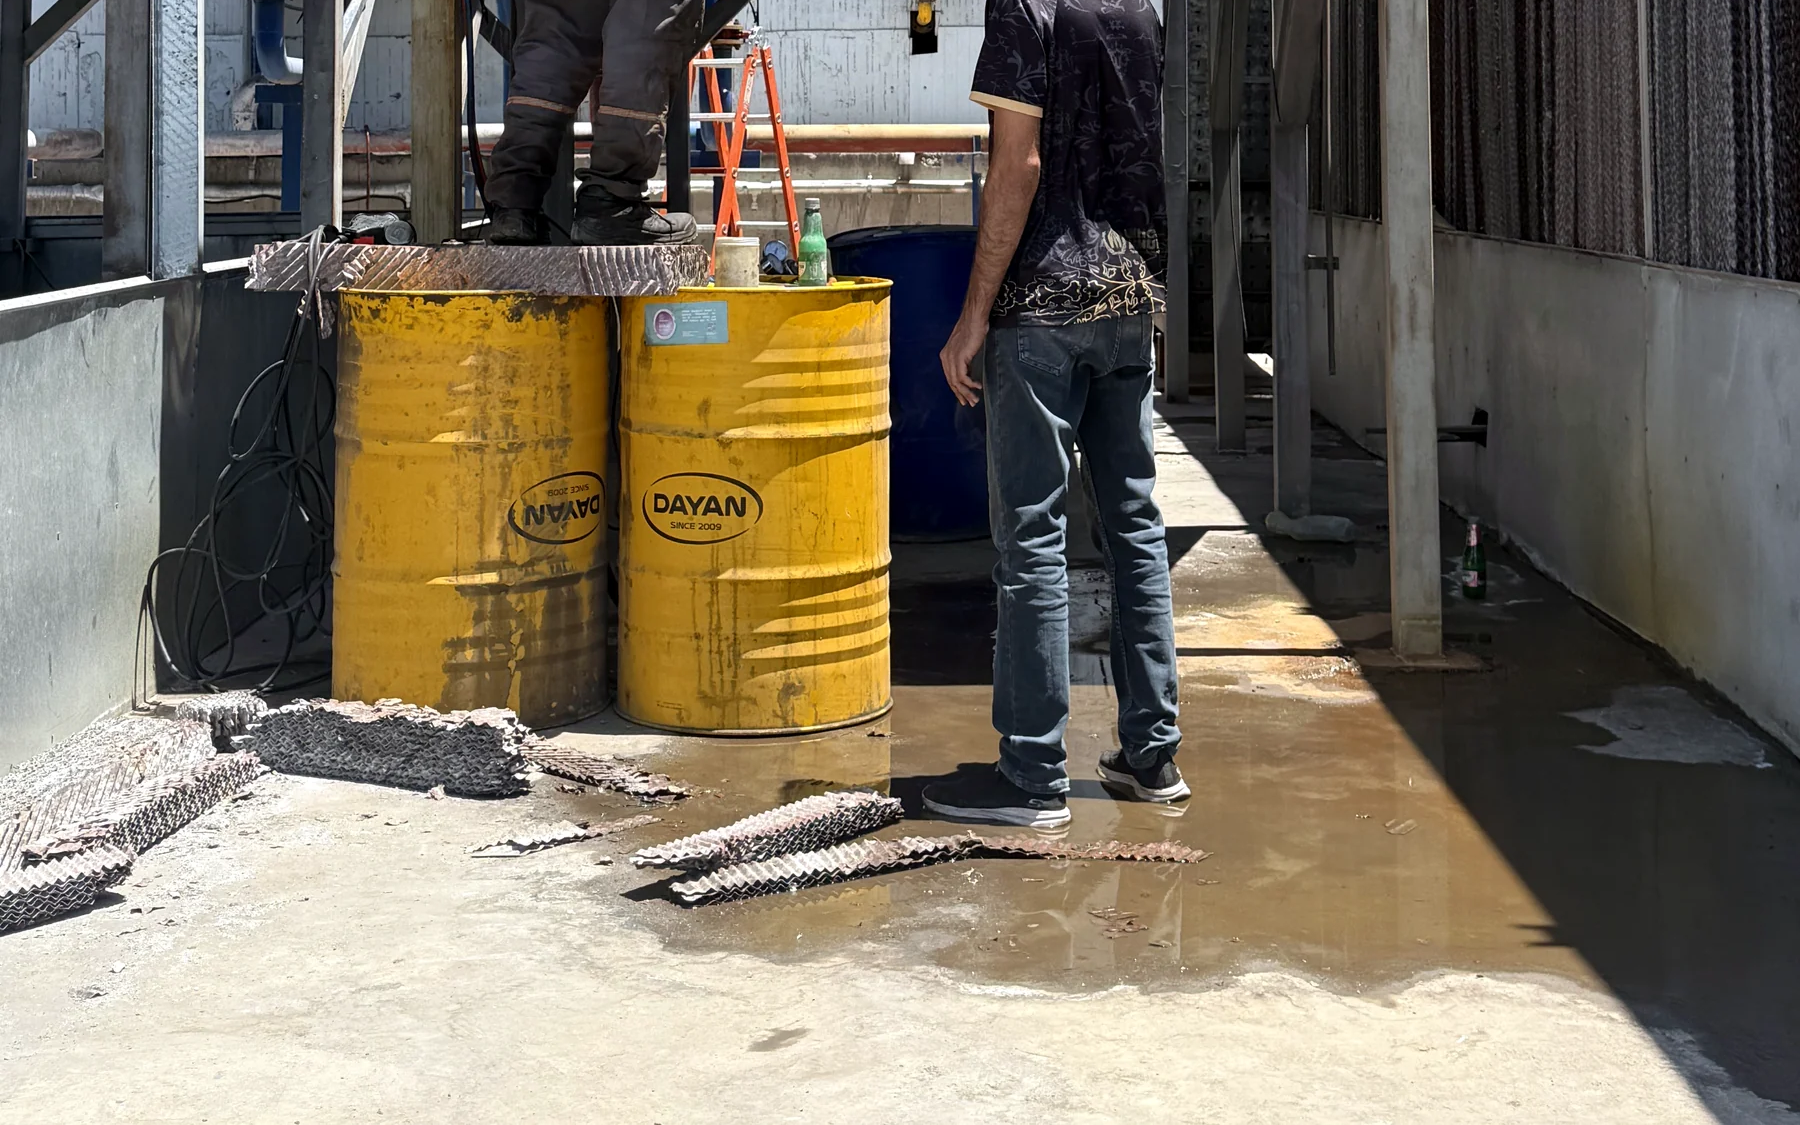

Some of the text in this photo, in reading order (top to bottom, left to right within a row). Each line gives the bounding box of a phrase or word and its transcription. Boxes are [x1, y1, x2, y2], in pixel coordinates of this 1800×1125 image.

[547, 483, 590, 497] SINCE 2009
[524, 493, 600, 526] DAYAN
[653, 493, 747, 518] DAYAN
[670, 521, 722, 531] SINCE 2009
